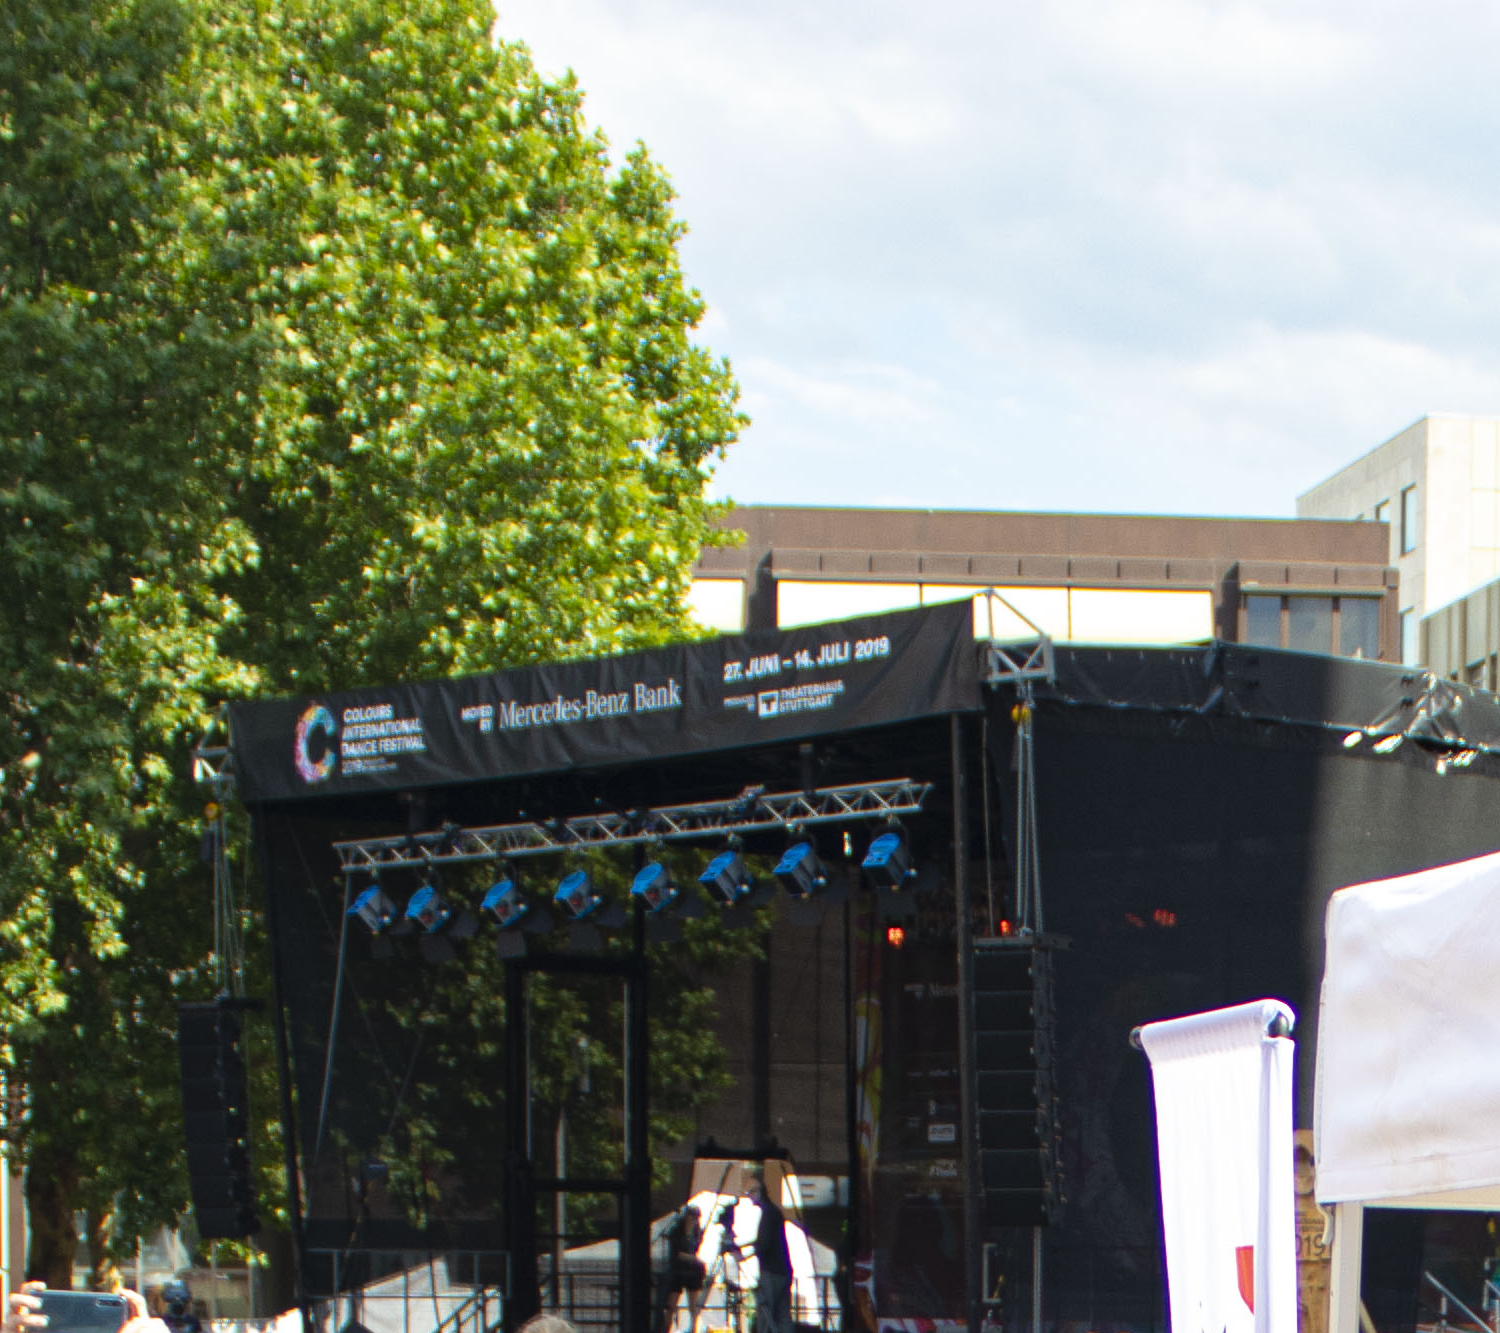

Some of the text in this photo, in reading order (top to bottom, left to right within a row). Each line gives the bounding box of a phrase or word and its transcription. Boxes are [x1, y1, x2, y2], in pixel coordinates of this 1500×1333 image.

[745, 652, 781, 680] JUNI
[795, 649, 816, 670] 14.
[817, 641, 850, 666] JULI
[854, 635, 891, 660] 2019
[343, 704, 394, 724] COLOURS
[500, 678, 682, 729] Mercedes-Benz Bank
[342, 718, 423, 741] INTERNATIONAL
[341, 735, 427, 758] DANCE FESTIVAL
